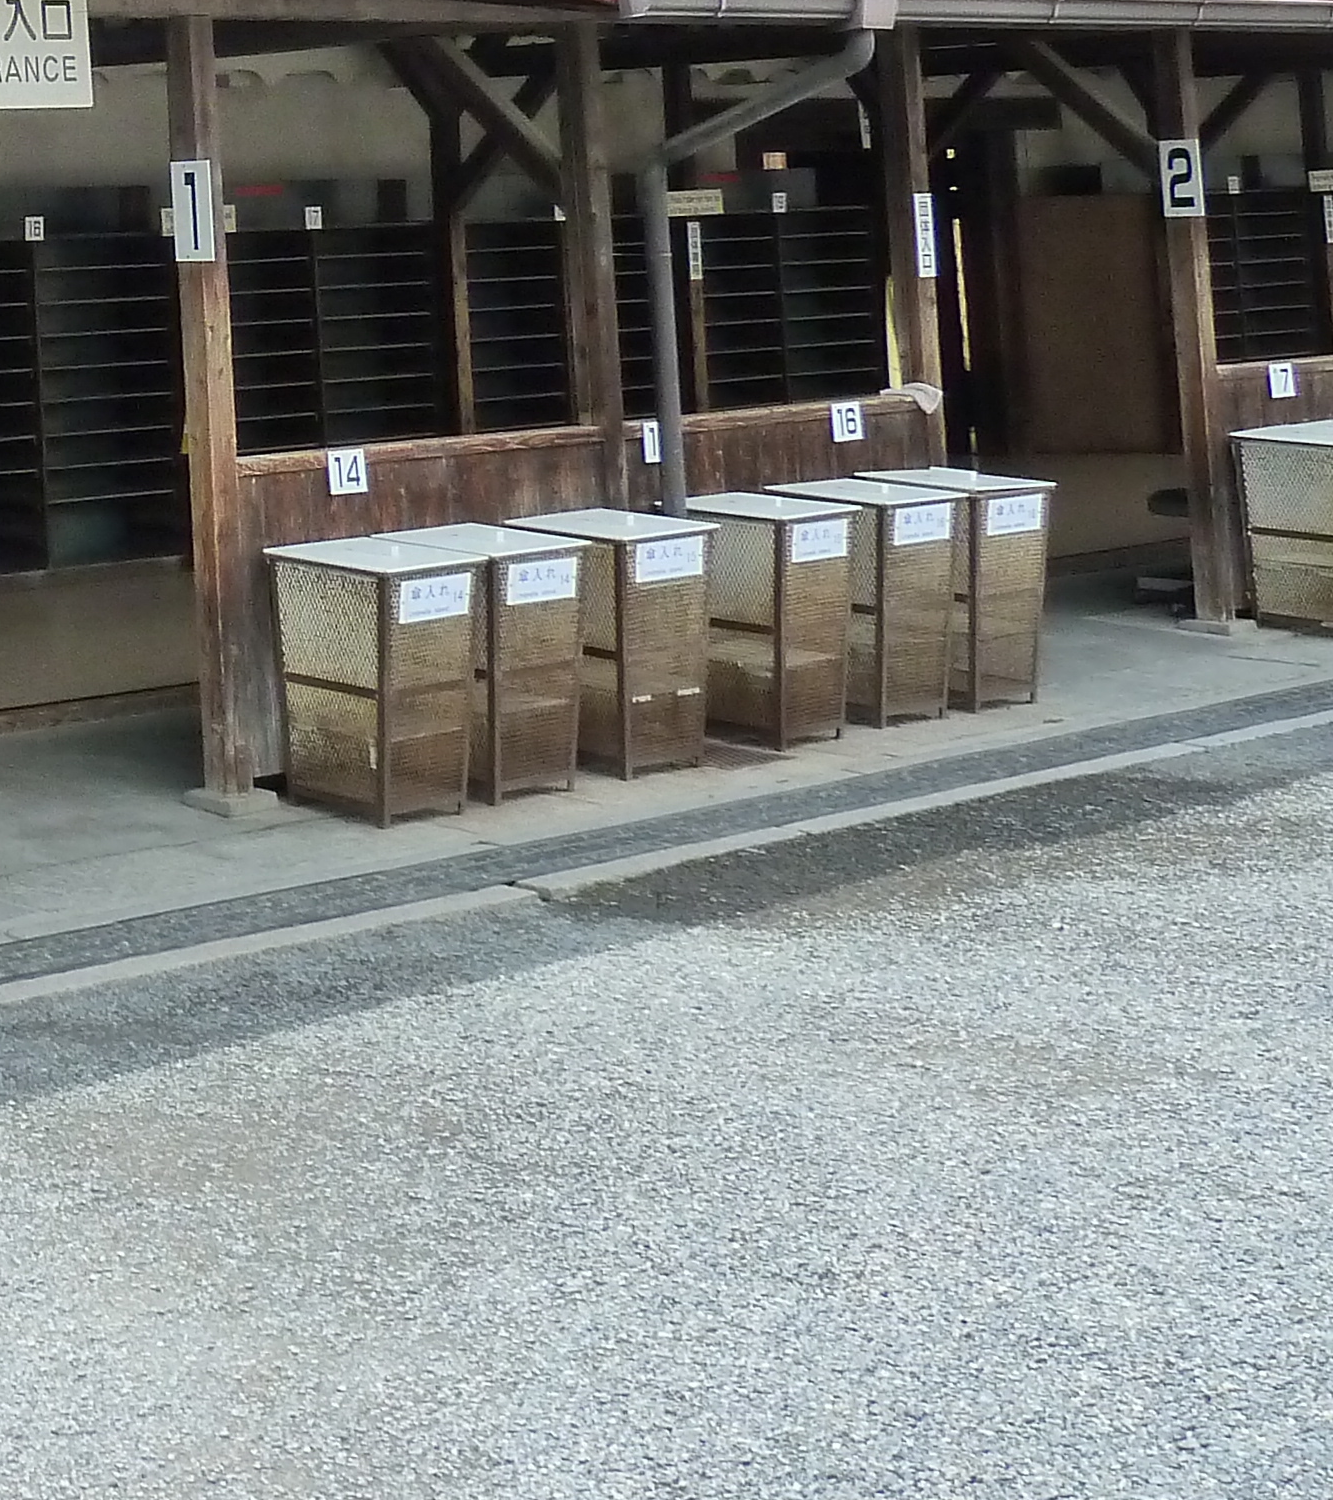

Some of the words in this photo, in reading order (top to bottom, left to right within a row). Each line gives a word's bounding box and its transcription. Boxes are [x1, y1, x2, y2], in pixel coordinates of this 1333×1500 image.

[1165, 146, 1195, 209] 2
[182, 170, 200, 251] 1
[835, 406, 859, 437] 16
[647, 426, 660, 458] 1
[332, 455, 360, 489] 14
